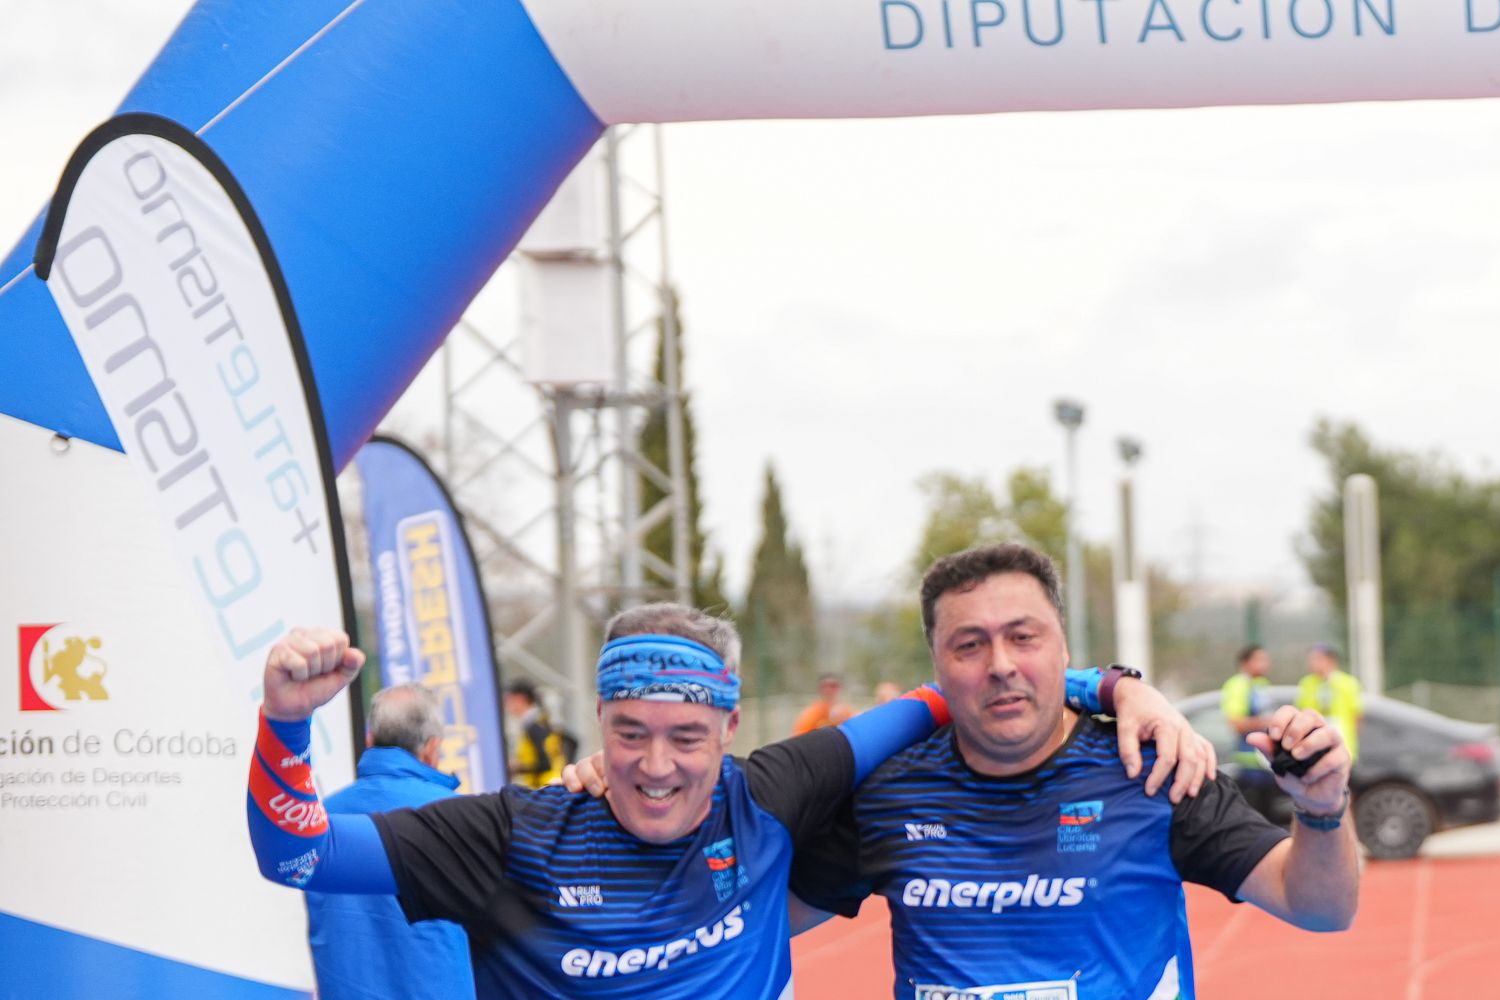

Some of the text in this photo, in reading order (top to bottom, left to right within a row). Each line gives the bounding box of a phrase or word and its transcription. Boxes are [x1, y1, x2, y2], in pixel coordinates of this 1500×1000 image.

[63, 729, 102, 755] de
[113, 727, 238, 757] Córdoba
[61, 769, 87, 785] de
[92, 767, 183, 788] Deportes
[105, 791, 148, 808] Civil
[902, 874, 1086, 914] enerplus
